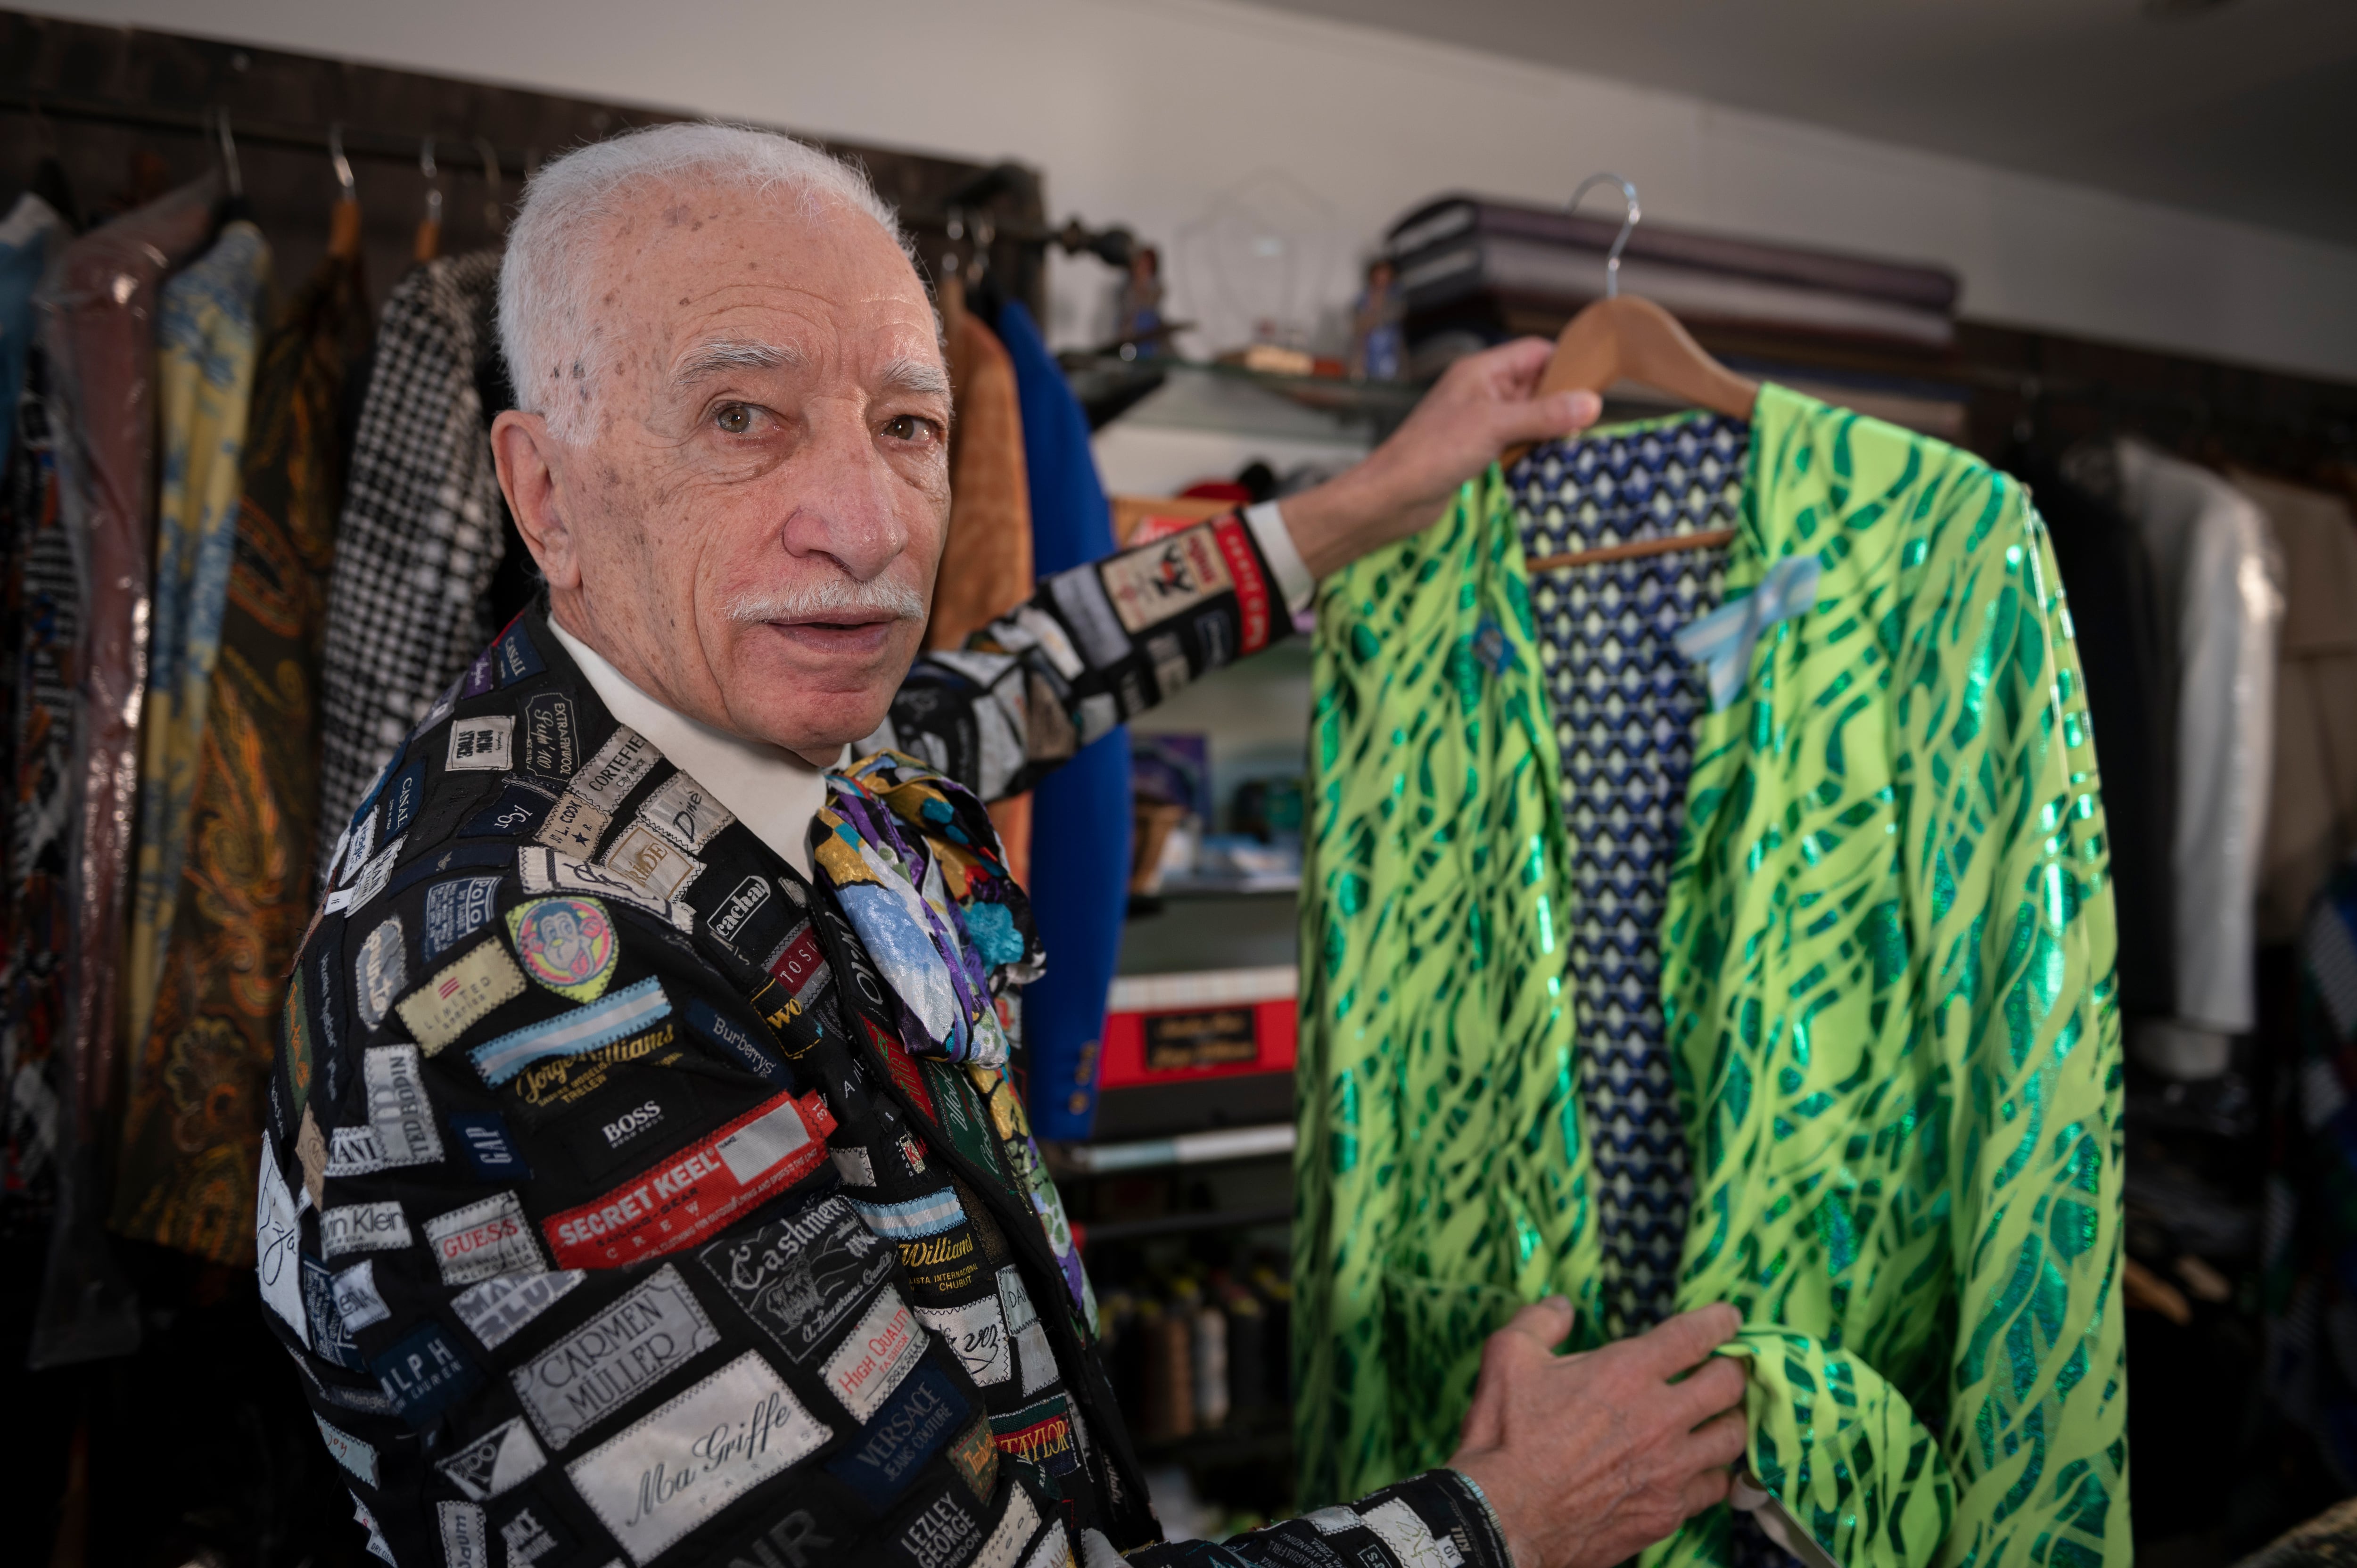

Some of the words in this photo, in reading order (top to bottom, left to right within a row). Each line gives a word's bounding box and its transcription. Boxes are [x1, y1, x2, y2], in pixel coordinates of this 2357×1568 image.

[505, 636, 526, 677] CANALI
[616, 773, 630, 788] City
[470, 878, 489, 924] Polo
[571, 1023, 675, 1063] illiams
[602, 1100, 661, 1143] BOSS
[465, 1126, 513, 1165] GAP
[558, 1184, 654, 1247] SECRET
[652, 1151, 722, 1200] KEEL
[353, 1207, 404, 1234] Klein
[443, 1218, 519, 1258] GUESS
[729, 1195, 847, 1290] Cashmere
[898, 1232, 973, 1268] Williams
[933, 1263, 979, 1283] INTERNACIONAL
[939, 1276, 972, 1292] CHUBUT
[540, 1292, 664, 1388] CARMEN
[838, 1355, 877, 1395] HIGH
[869, 1306, 911, 1357] QUALITY
[879, 1333, 909, 1373] FASHION
[565, 1332, 682, 1421] MÜLLER
[856, 1380, 941, 1467] VERSACE
[911, 1402, 953, 1450] COUTURE
[1000, 1420, 1071, 1463] TAYLOR
[900, 1490, 958, 1555] LEZLEY
[917, 1508, 976, 1568] GEORGE
[370, 1542, 383, 1556] DRY
[942, 1527, 982, 1568] ONDON
